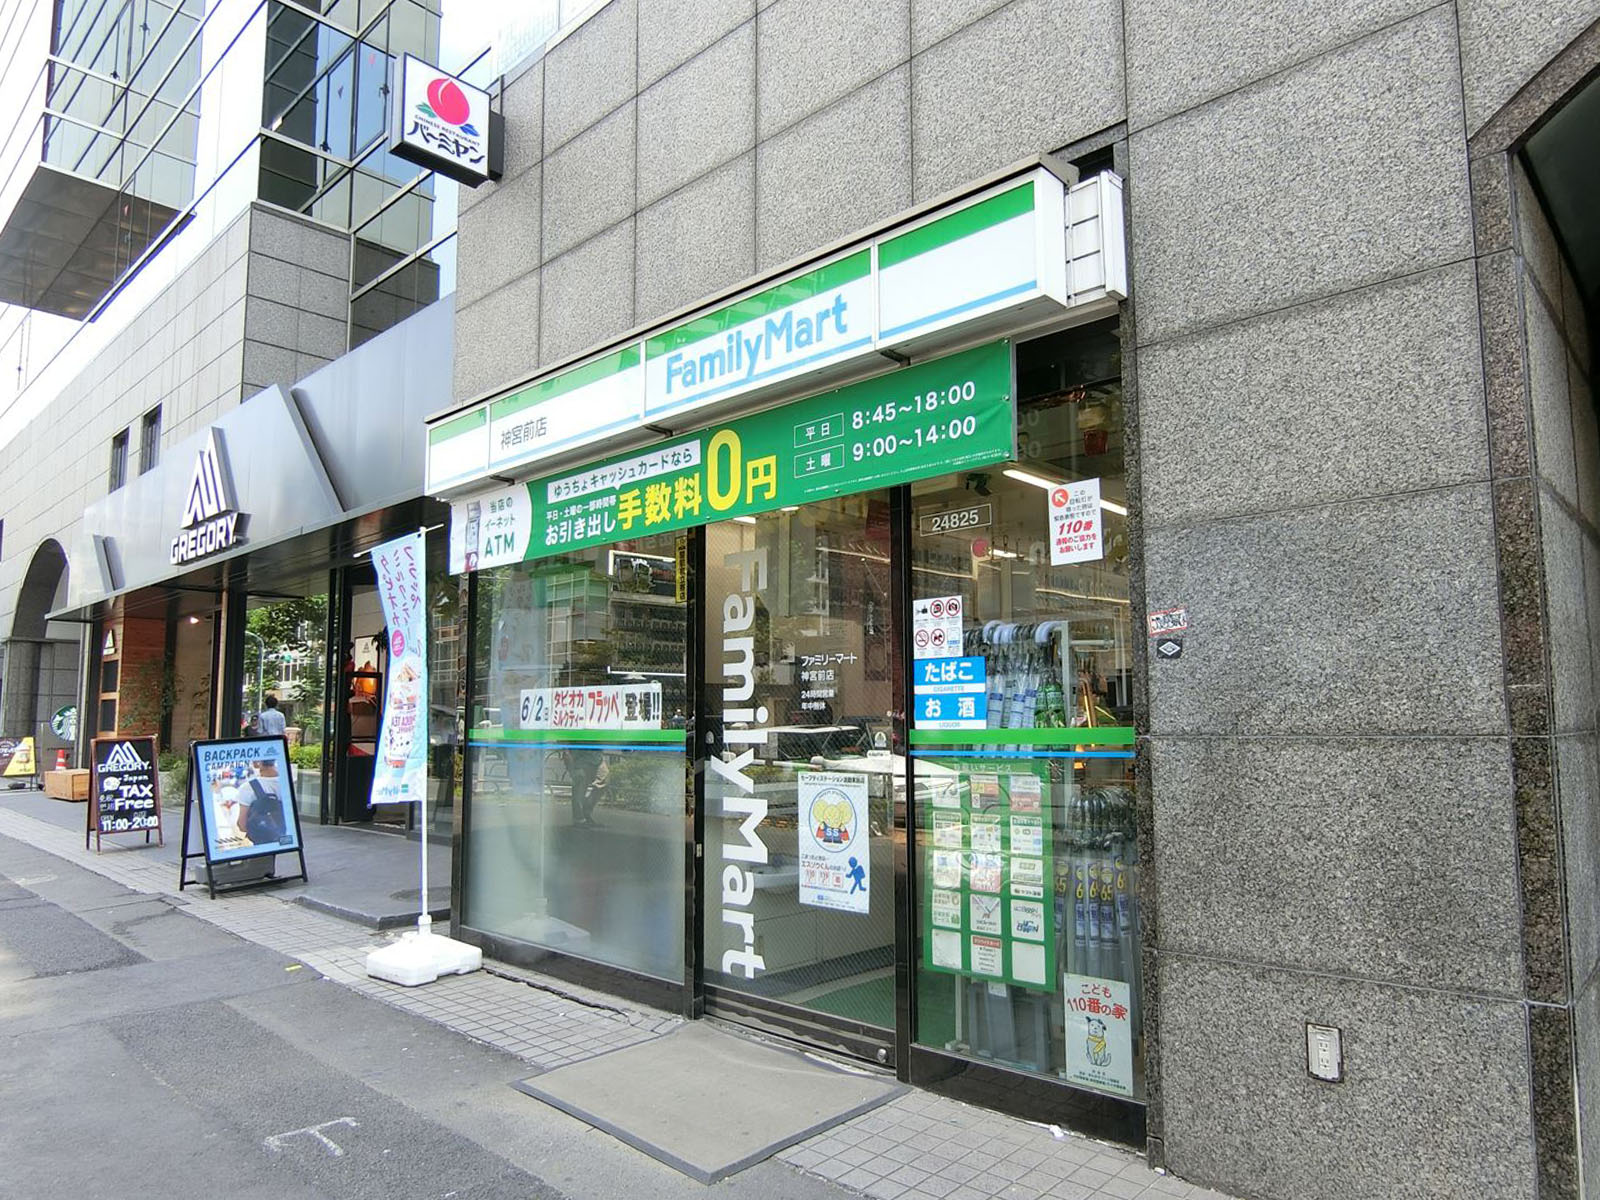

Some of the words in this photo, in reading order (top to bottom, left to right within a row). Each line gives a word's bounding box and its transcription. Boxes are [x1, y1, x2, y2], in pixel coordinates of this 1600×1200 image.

[415, 114, 440, 129] CHINESE
[441, 126, 480, 147] RESTAURANT
[407, 120, 485, 164] バーミヤン
[666, 294, 848, 394] FamilyMart
[501, 417, 547, 450] 神宮前店
[805, 422, 830, 440] 平日
[805, 452, 831, 472] 土曜
[554, 448, 693, 496] ゆうちょキャッシュカードなら
[489, 497, 513, 513] 当店の
[485, 514, 515, 531] イーネット
[545, 512, 616, 547] お引き出し
[931, 510, 979, 532] 24825
[1059, 520, 1094, 535] 110番
[485, 532, 515, 558] ATM
[1059, 542, 1095, 553] お願いします
[801, 652, 857, 667] ファミリーマート
[801, 669, 835, 681] 神宮前店
[925, 661, 974, 682] たばこ
[925, 697, 975, 718] お酒
[204, 747, 260, 762] BACKPACK
[711, 548, 769, 979] FamilyMart
[205, 760, 250, 771] CAMPAIGN
[123, 774, 149, 783] Japan
[119, 784, 154, 798] TAX
[115, 798, 154, 811] Free
[1081, 983, 1112, 998] こども
[1067, 997, 1128, 1021] 110番の家
